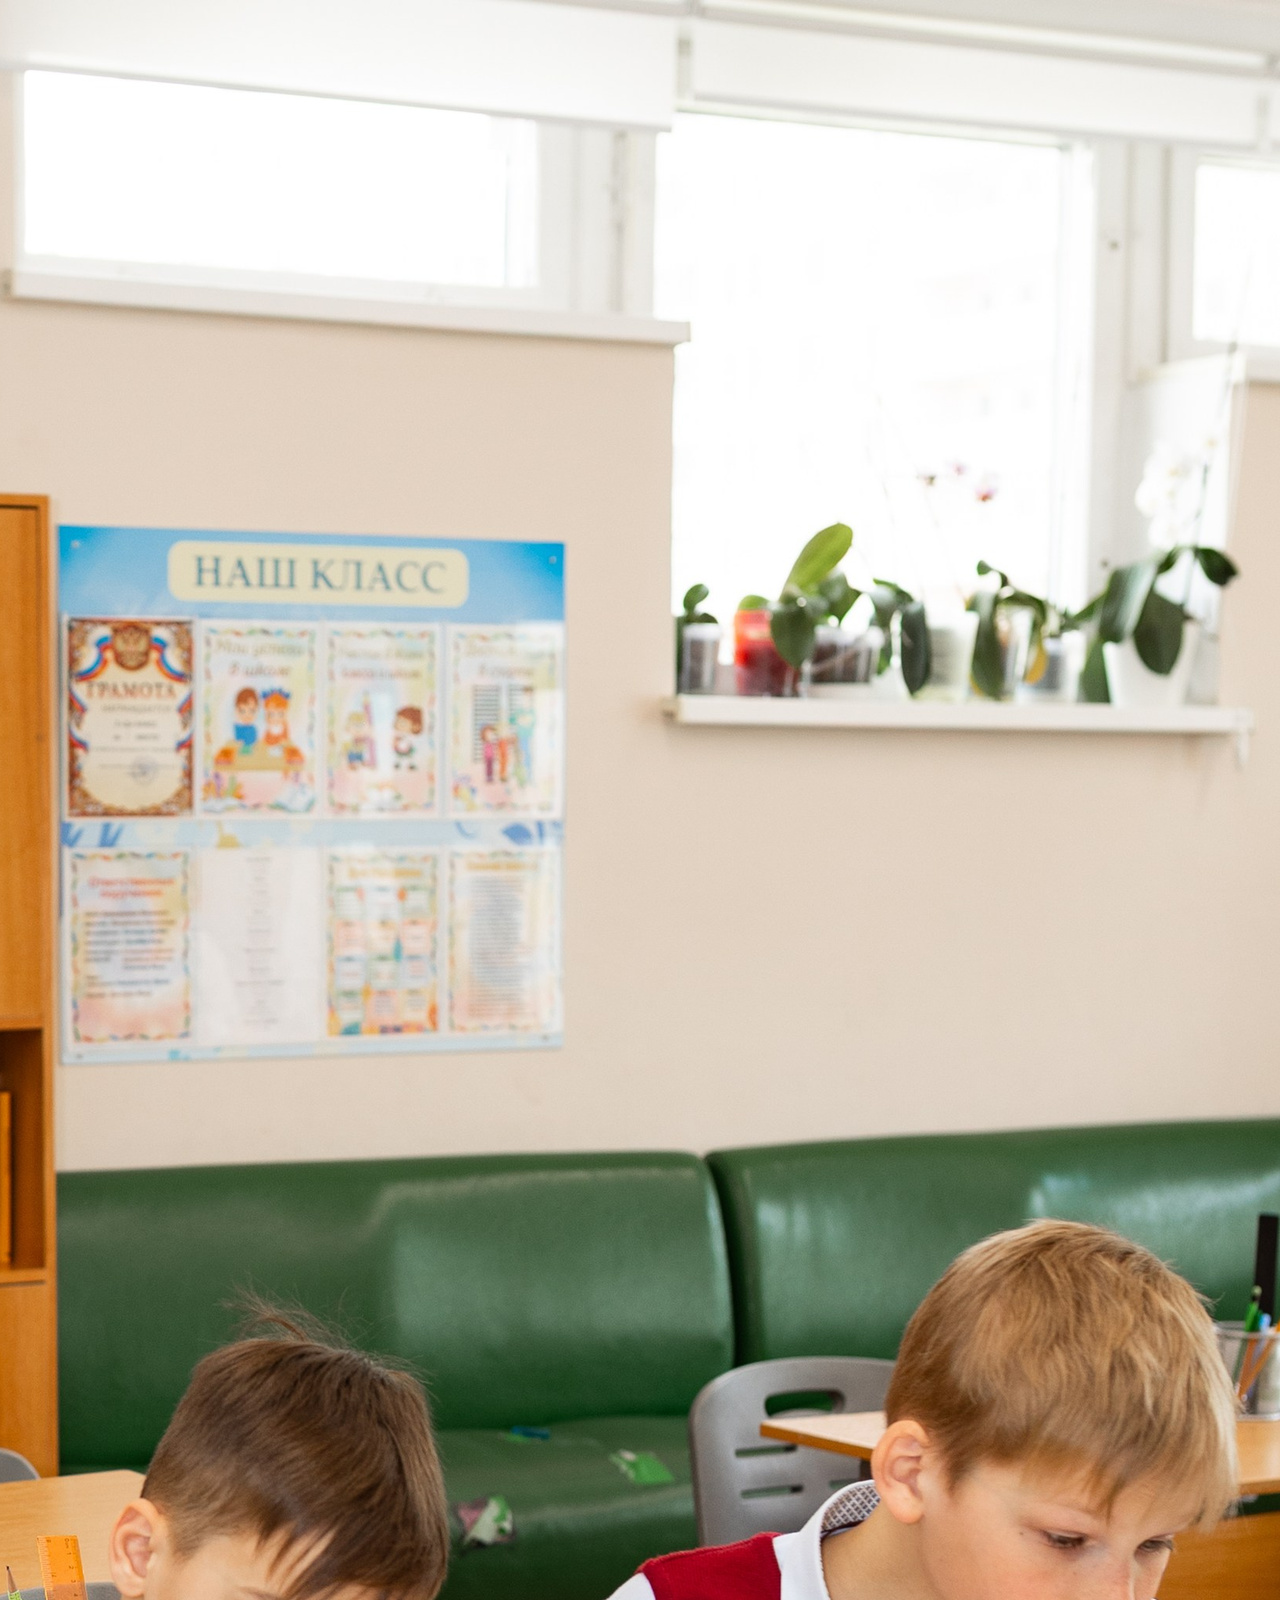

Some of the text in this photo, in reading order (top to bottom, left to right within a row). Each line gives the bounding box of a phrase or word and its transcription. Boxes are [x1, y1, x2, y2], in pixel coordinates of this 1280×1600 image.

[194, 554, 449, 594] НАШ КЛАСС
[85, 681, 178, 700] ГРАМОТА
